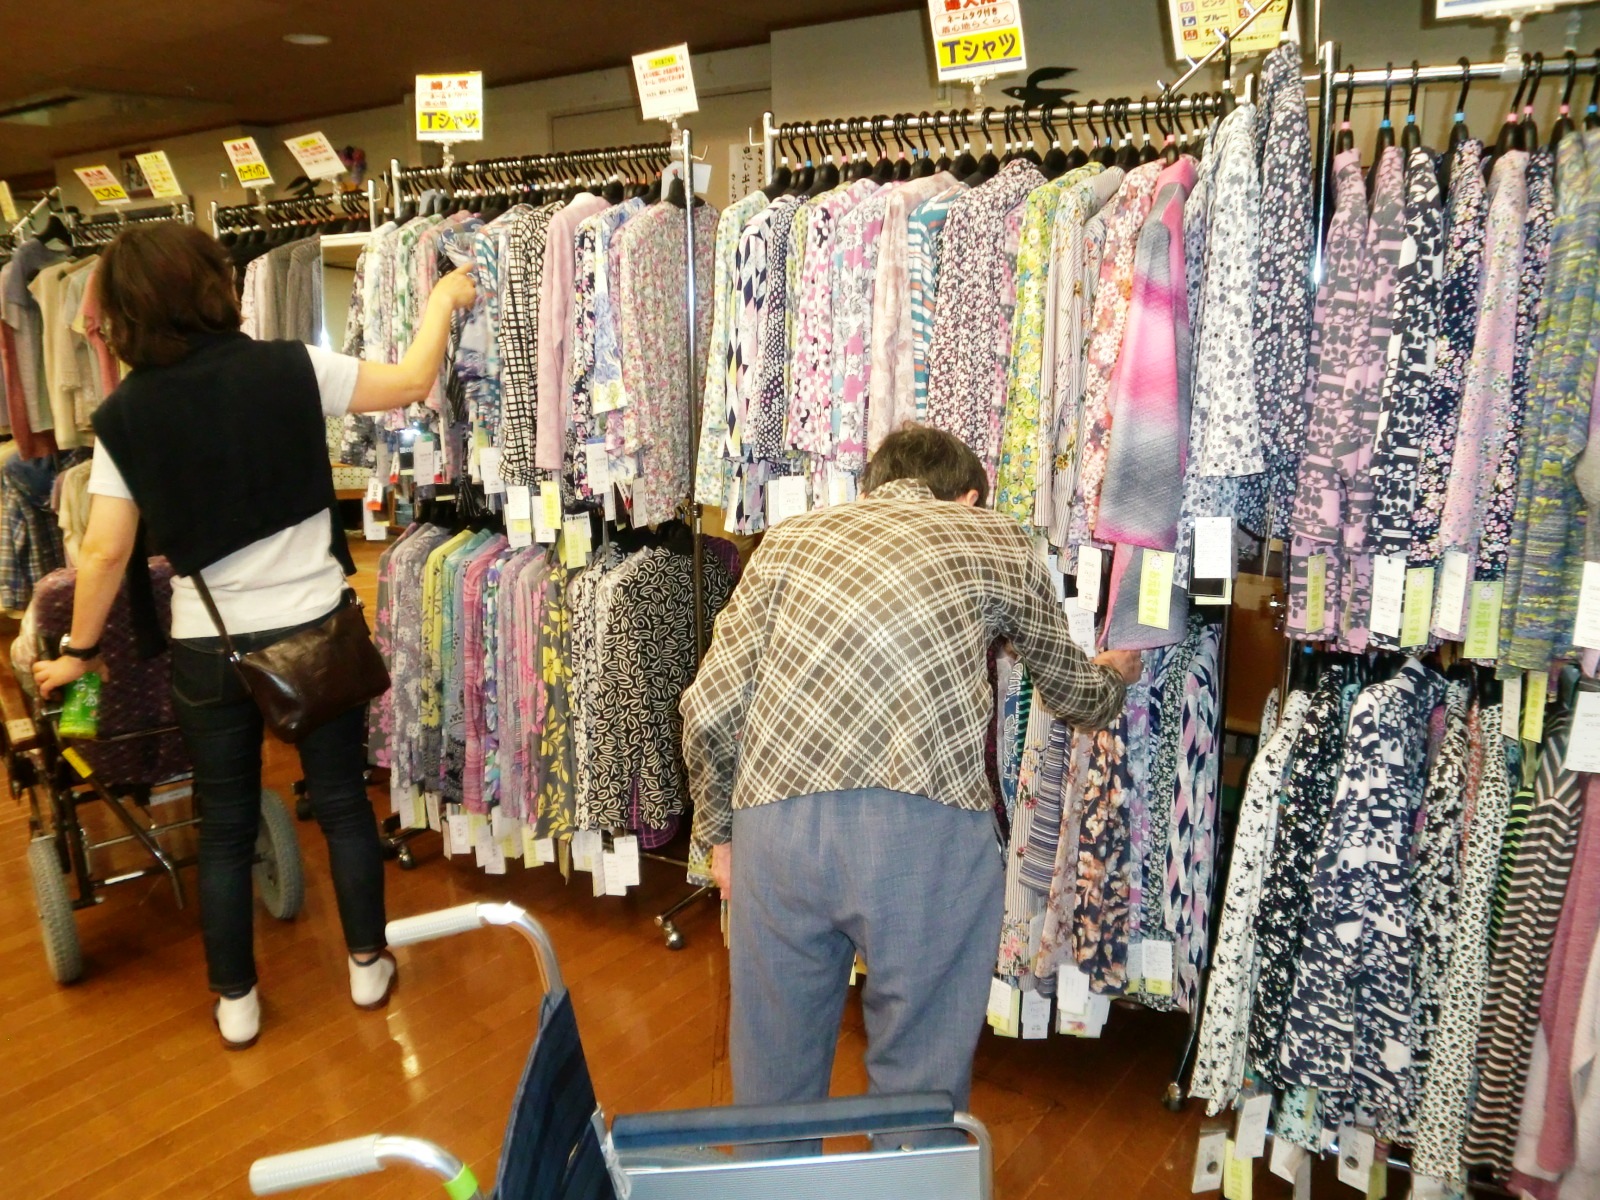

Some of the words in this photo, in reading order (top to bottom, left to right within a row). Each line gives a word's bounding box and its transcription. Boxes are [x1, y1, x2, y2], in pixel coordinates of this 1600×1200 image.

[942, 33, 1016, 64] Tシャツ
[422, 111, 477, 129] Tシャツ
[94, 186, 122, 198] ベスト
